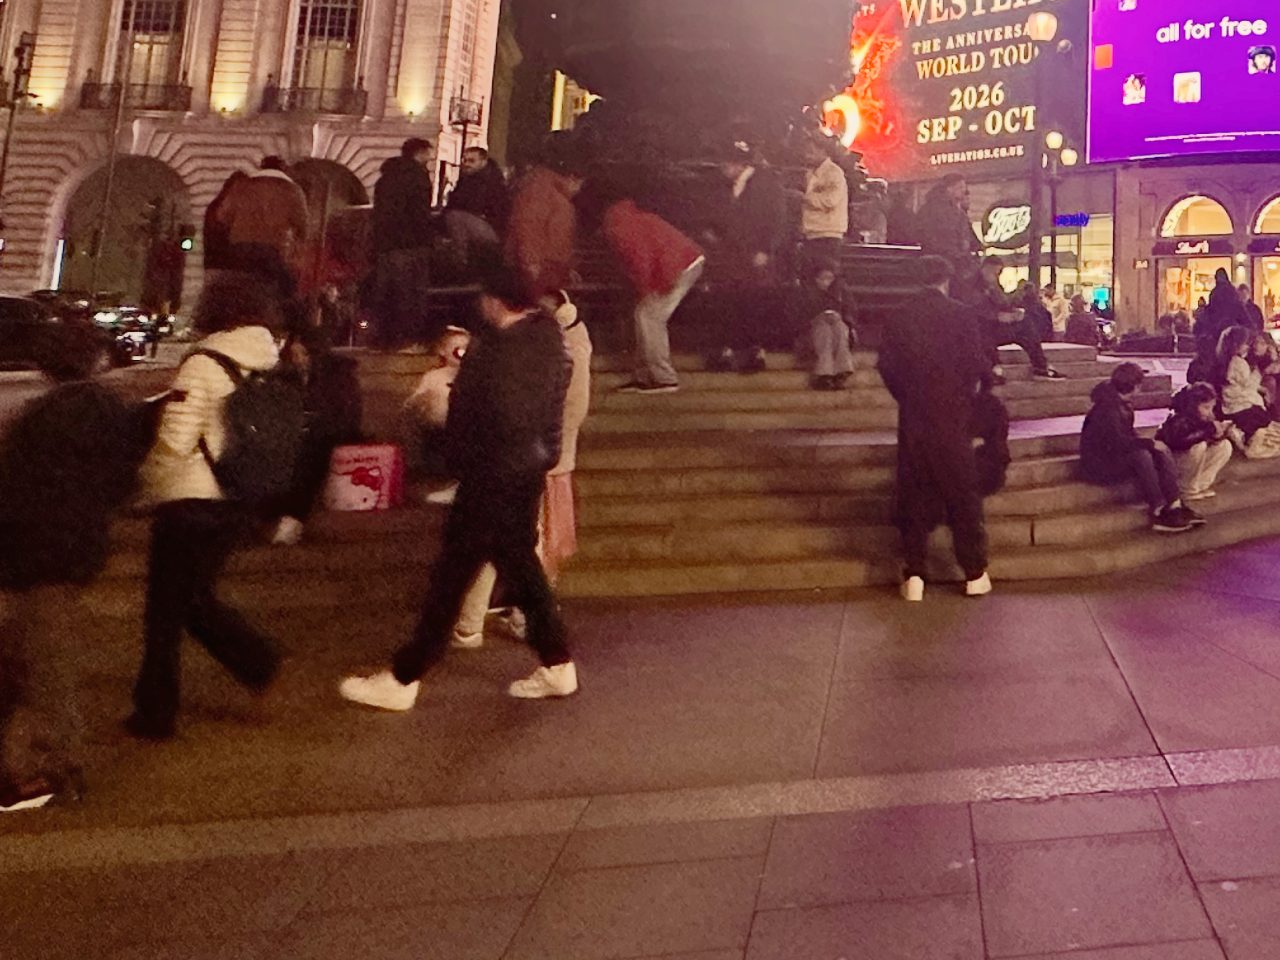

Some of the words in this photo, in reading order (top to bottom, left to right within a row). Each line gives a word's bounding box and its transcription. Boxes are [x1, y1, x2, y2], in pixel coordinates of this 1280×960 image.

[912, 38, 942, 56] THE
[945, 21, 1030, 50] ANNIVERSA
[1155, 22, 1180, 43] all
[1183, 19, 1215, 40] for
[1219, 16, 1268, 38] free
[915, 51, 986, 81] WORLD
[989, 41, 1040, 68] TOU
[948, 80, 1006, 112] 2026
[916, 115, 963, 144] SEP
[984, 105, 1037, 136] OCT
